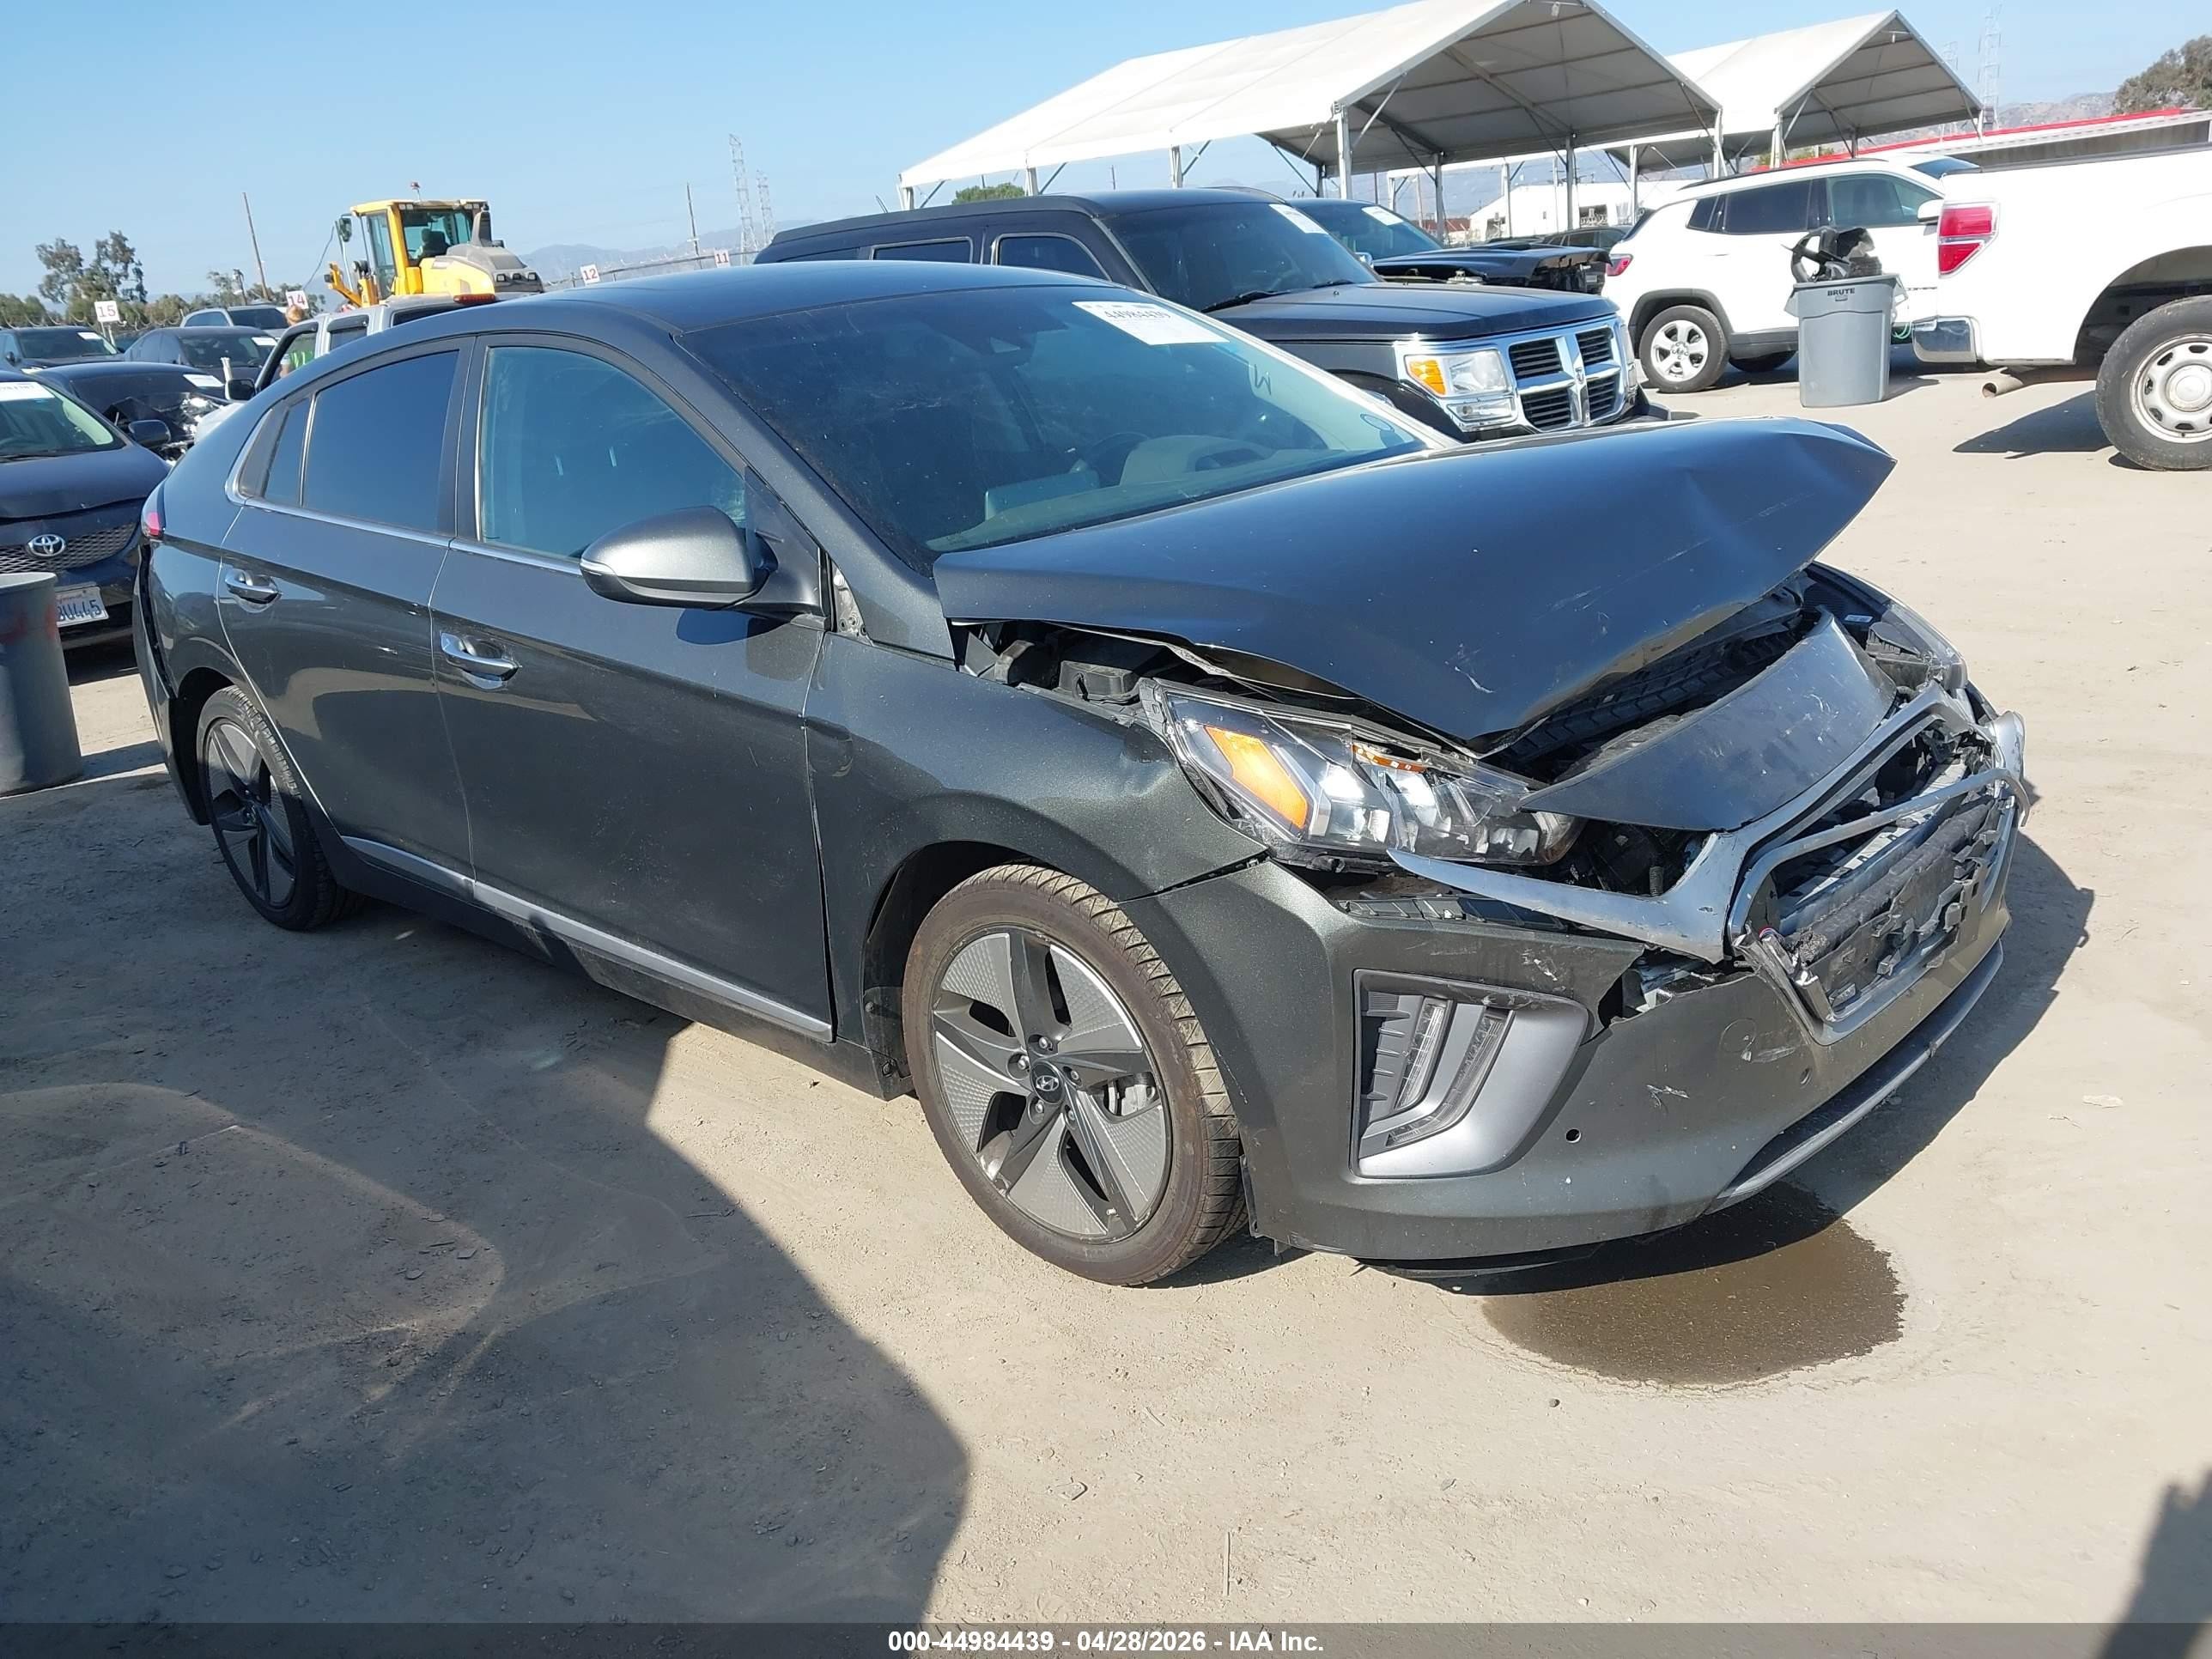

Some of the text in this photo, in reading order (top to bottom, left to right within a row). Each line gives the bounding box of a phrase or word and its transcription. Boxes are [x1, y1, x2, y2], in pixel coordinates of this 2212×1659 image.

[716, 252, 728, 264] 11
[583, 267, 598, 281] 12
[1827, 288, 1856, 296] BRUTE
[288, 295, 306, 307] 14
[97, 305, 116, 317] 15
